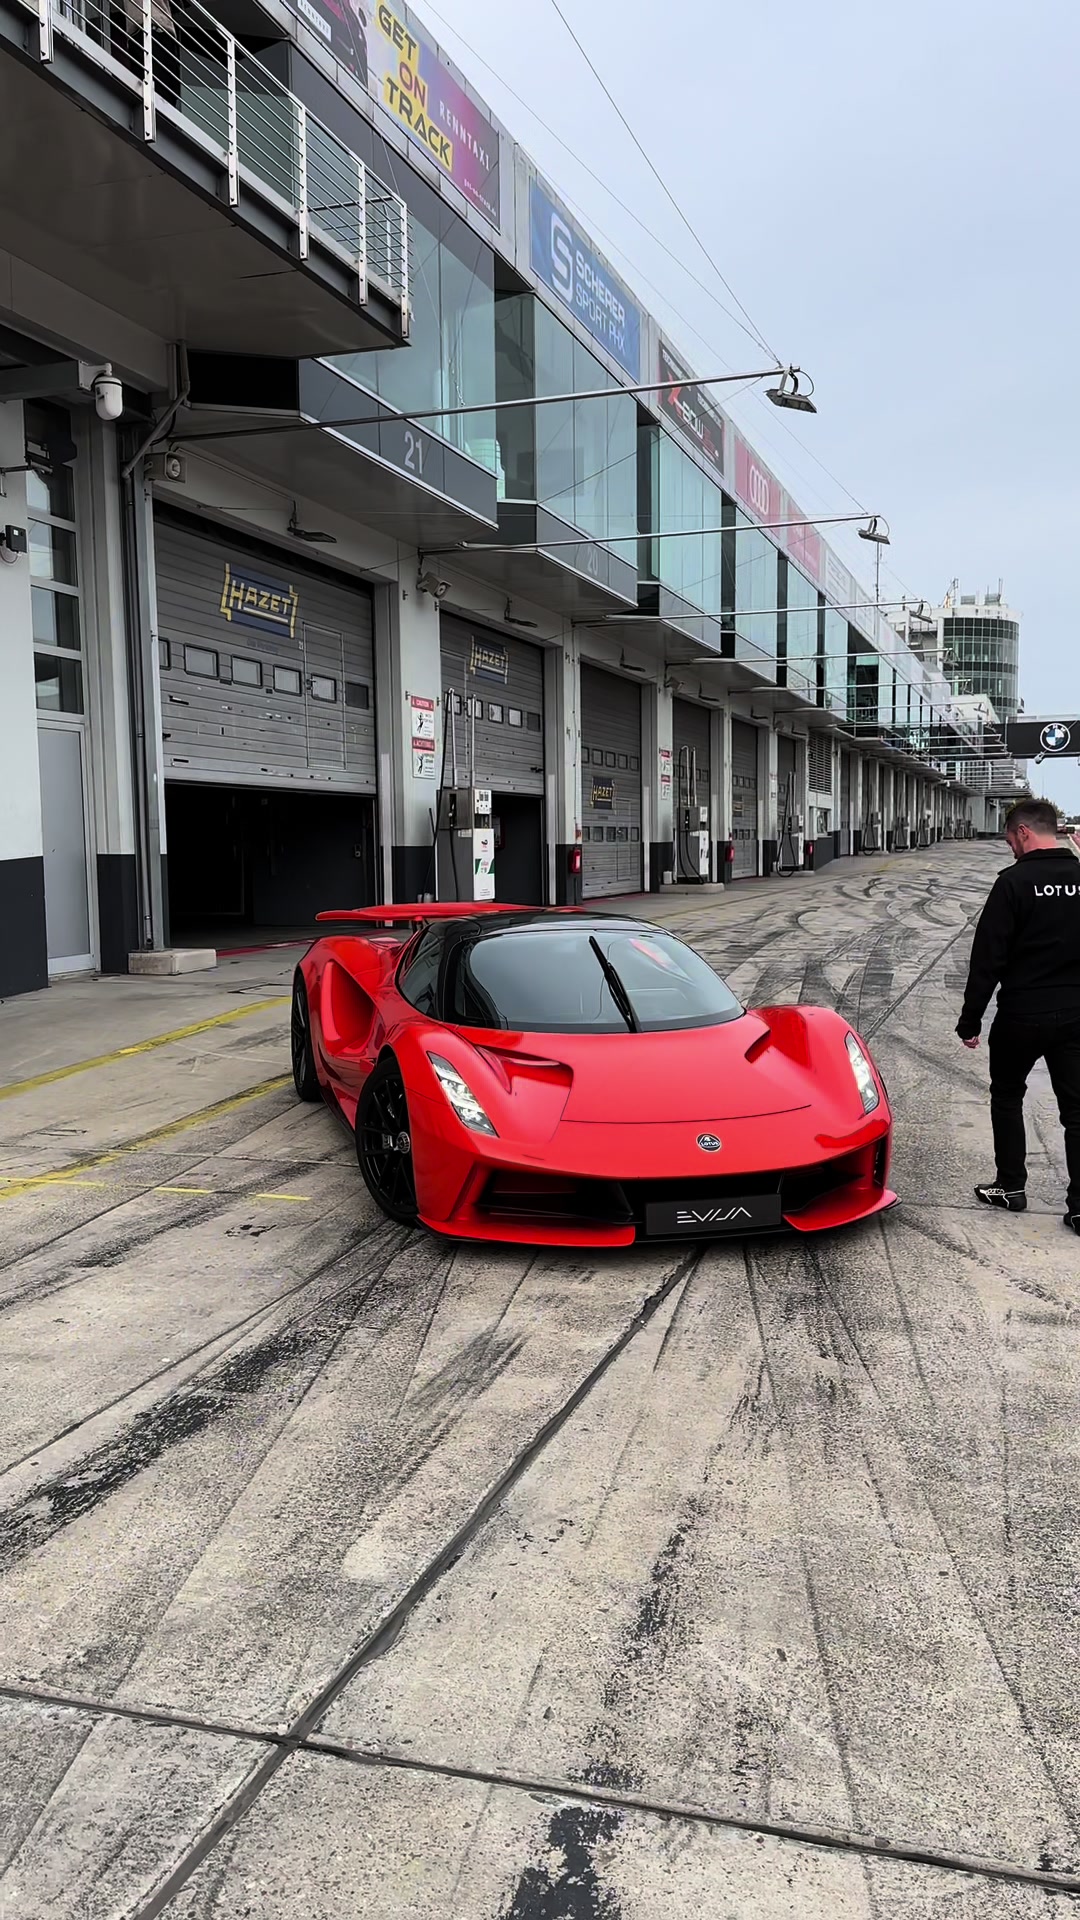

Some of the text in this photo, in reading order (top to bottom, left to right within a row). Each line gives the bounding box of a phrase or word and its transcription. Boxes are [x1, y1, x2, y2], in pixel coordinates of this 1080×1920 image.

[378, 5, 417, 60] GET
[399, 61, 427, 107] ON
[386, 77, 452, 167] TRACK
[439, 100, 490, 172] RENNTAXI
[575, 249, 626, 327] SCHERER
[575, 282, 626, 355] SPORT PHX
[404, 430, 423, 474] 21
[587, 547, 599, 577] 20
[229, 579, 291, 615] HAZET
[474, 645, 506, 668] HAZET
[592, 784, 613, 801] HAZET
[1034, 884, 1080, 897] LOTU
[676, 1206, 752, 1224] EVIJA
